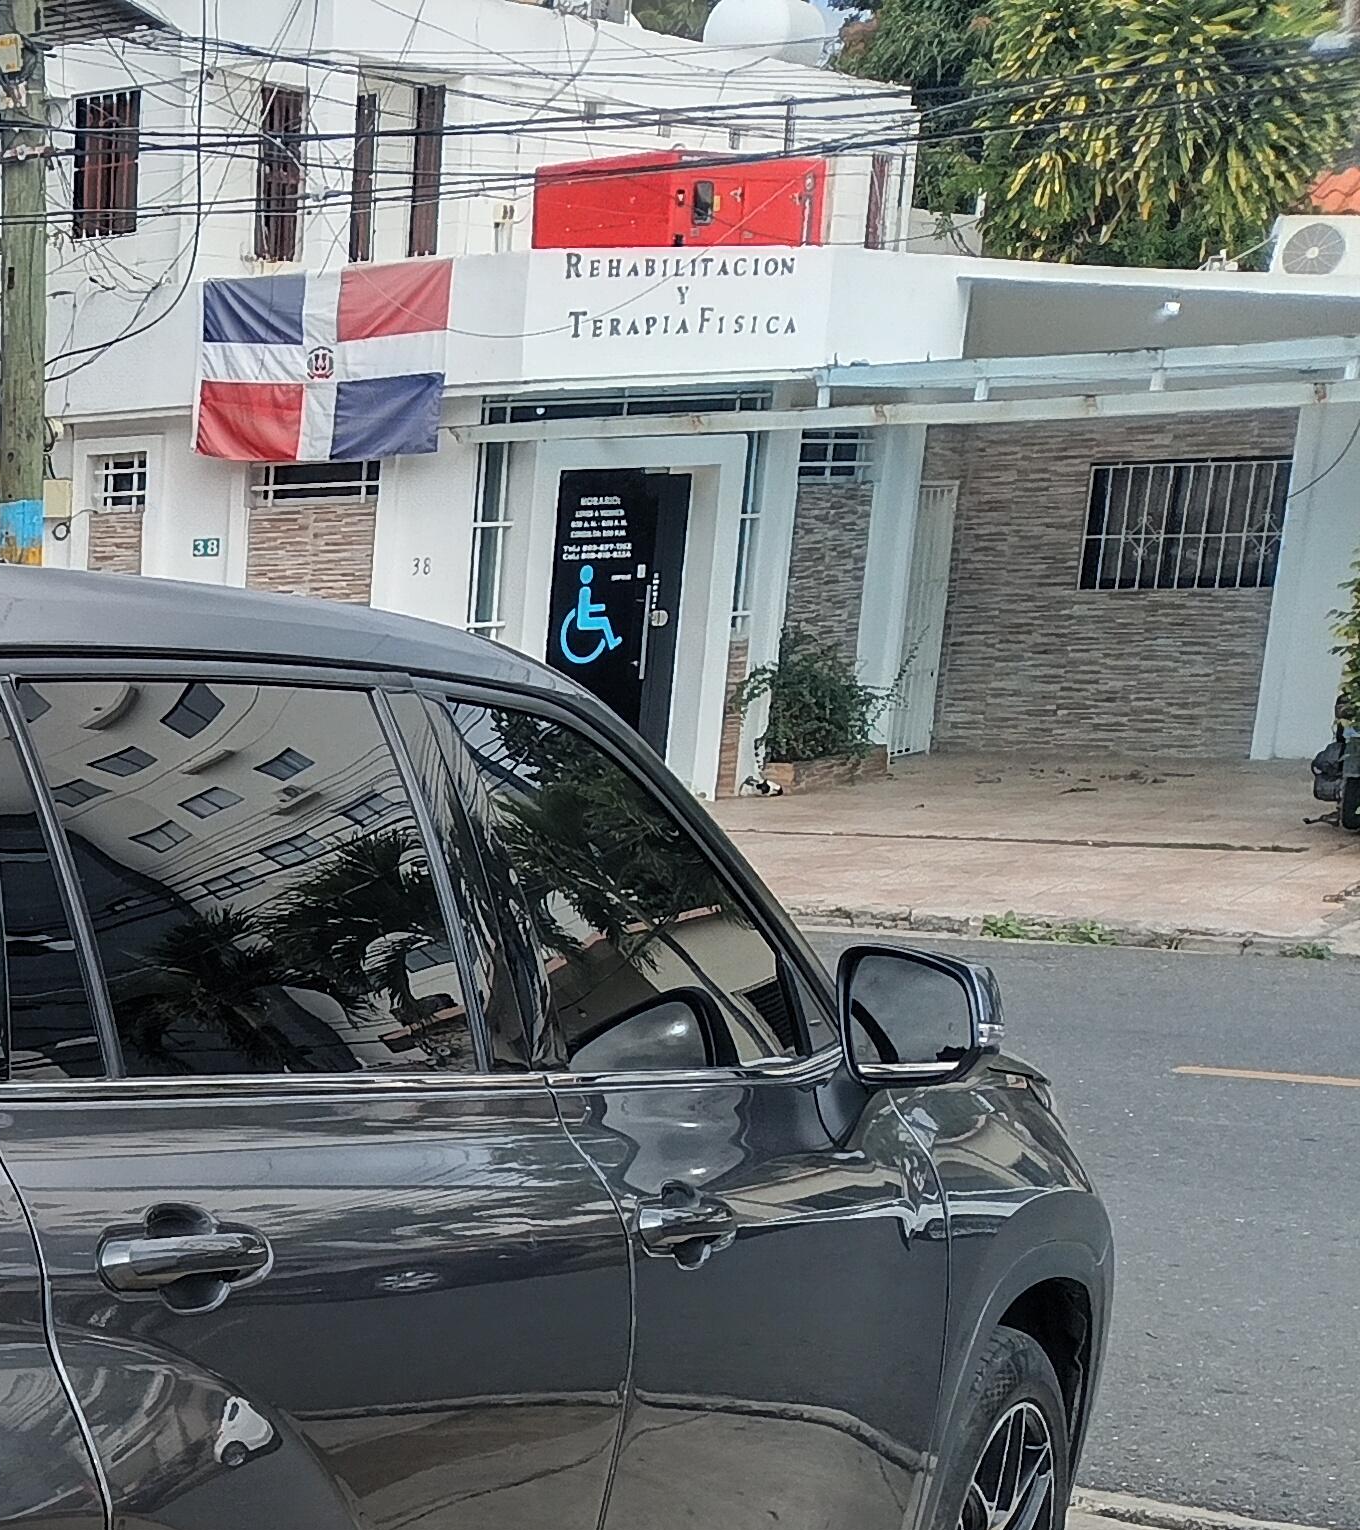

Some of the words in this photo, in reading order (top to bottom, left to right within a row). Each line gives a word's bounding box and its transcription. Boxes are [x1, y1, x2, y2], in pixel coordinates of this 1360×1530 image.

[565, 252, 796, 279] REHABILITACION
[677, 286, 689, 305] Y
[194, 540, 218, 555] 38
[412, 557, 431, 575] 38
